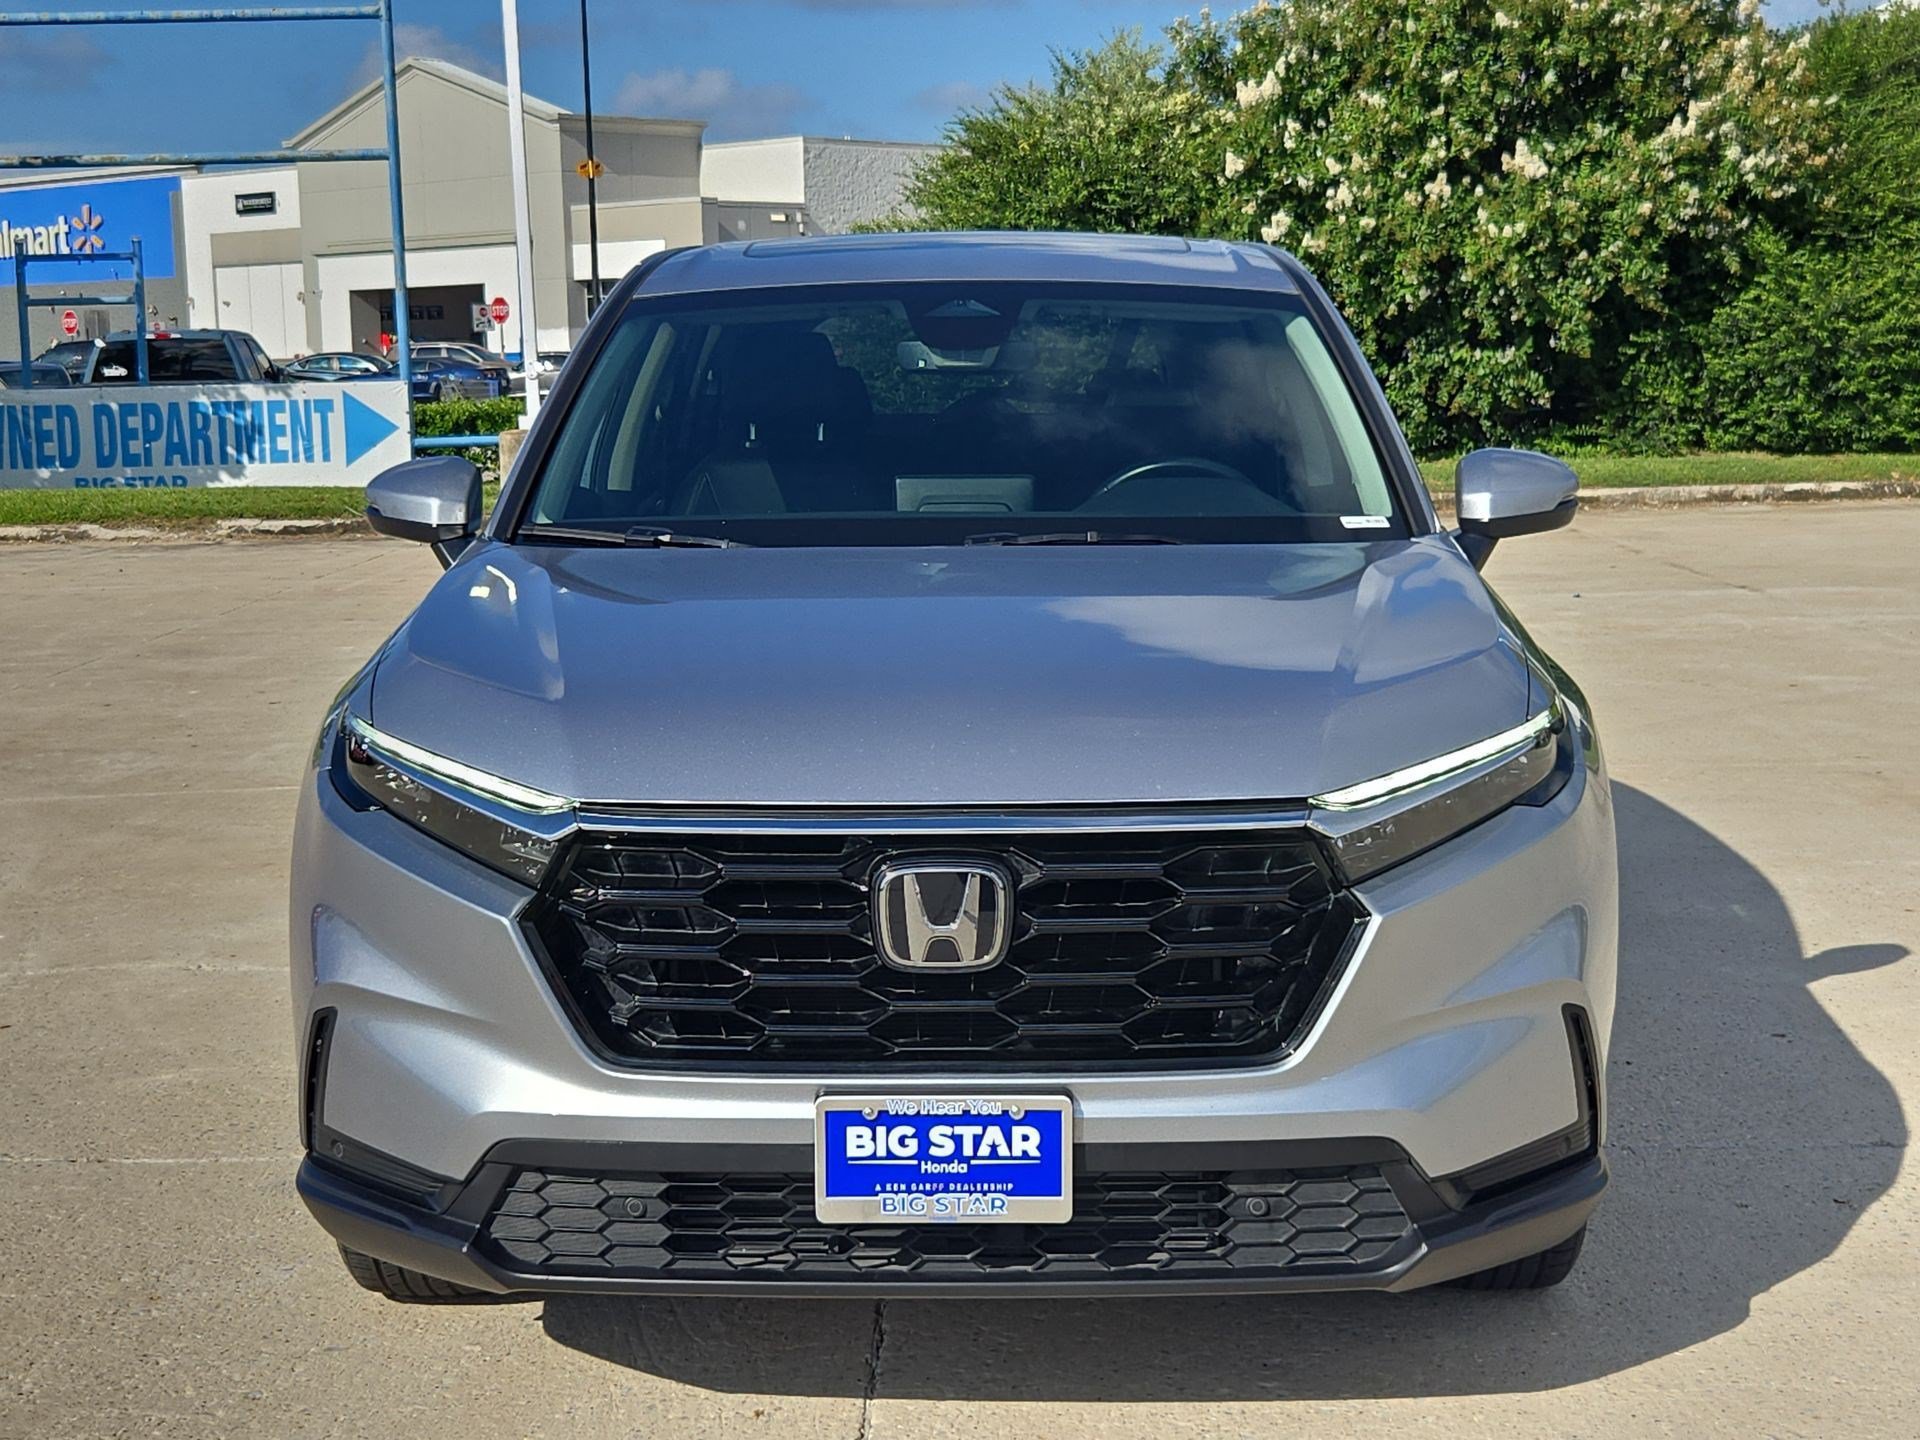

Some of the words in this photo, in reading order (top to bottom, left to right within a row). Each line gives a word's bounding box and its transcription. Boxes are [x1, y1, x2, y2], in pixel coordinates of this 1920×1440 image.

[0, 215, 70, 258] lmart
[492, 305, 509, 317] STOP
[0, 403, 81, 470] NED
[93, 399, 334, 468] DEPARTMENT
[886, 1100, 917, 1115] We
[920, 1100, 965, 1115] Hear
[966, 1100, 1002, 1115] You
[846, 1125, 918, 1158] BIG
[928, 1125, 1041, 1157] STAR
[920, 1159, 968, 1174] Honda
[874, 1182, 882, 1192] A
[885, 1182, 907, 1192] KEN
[910, 1182, 945, 1192] GARFF
[948, 1182, 1014, 1192] DEALERSHIP
[880, 1195, 926, 1213] BIG
[933, 1195, 1007, 1213] STAR
